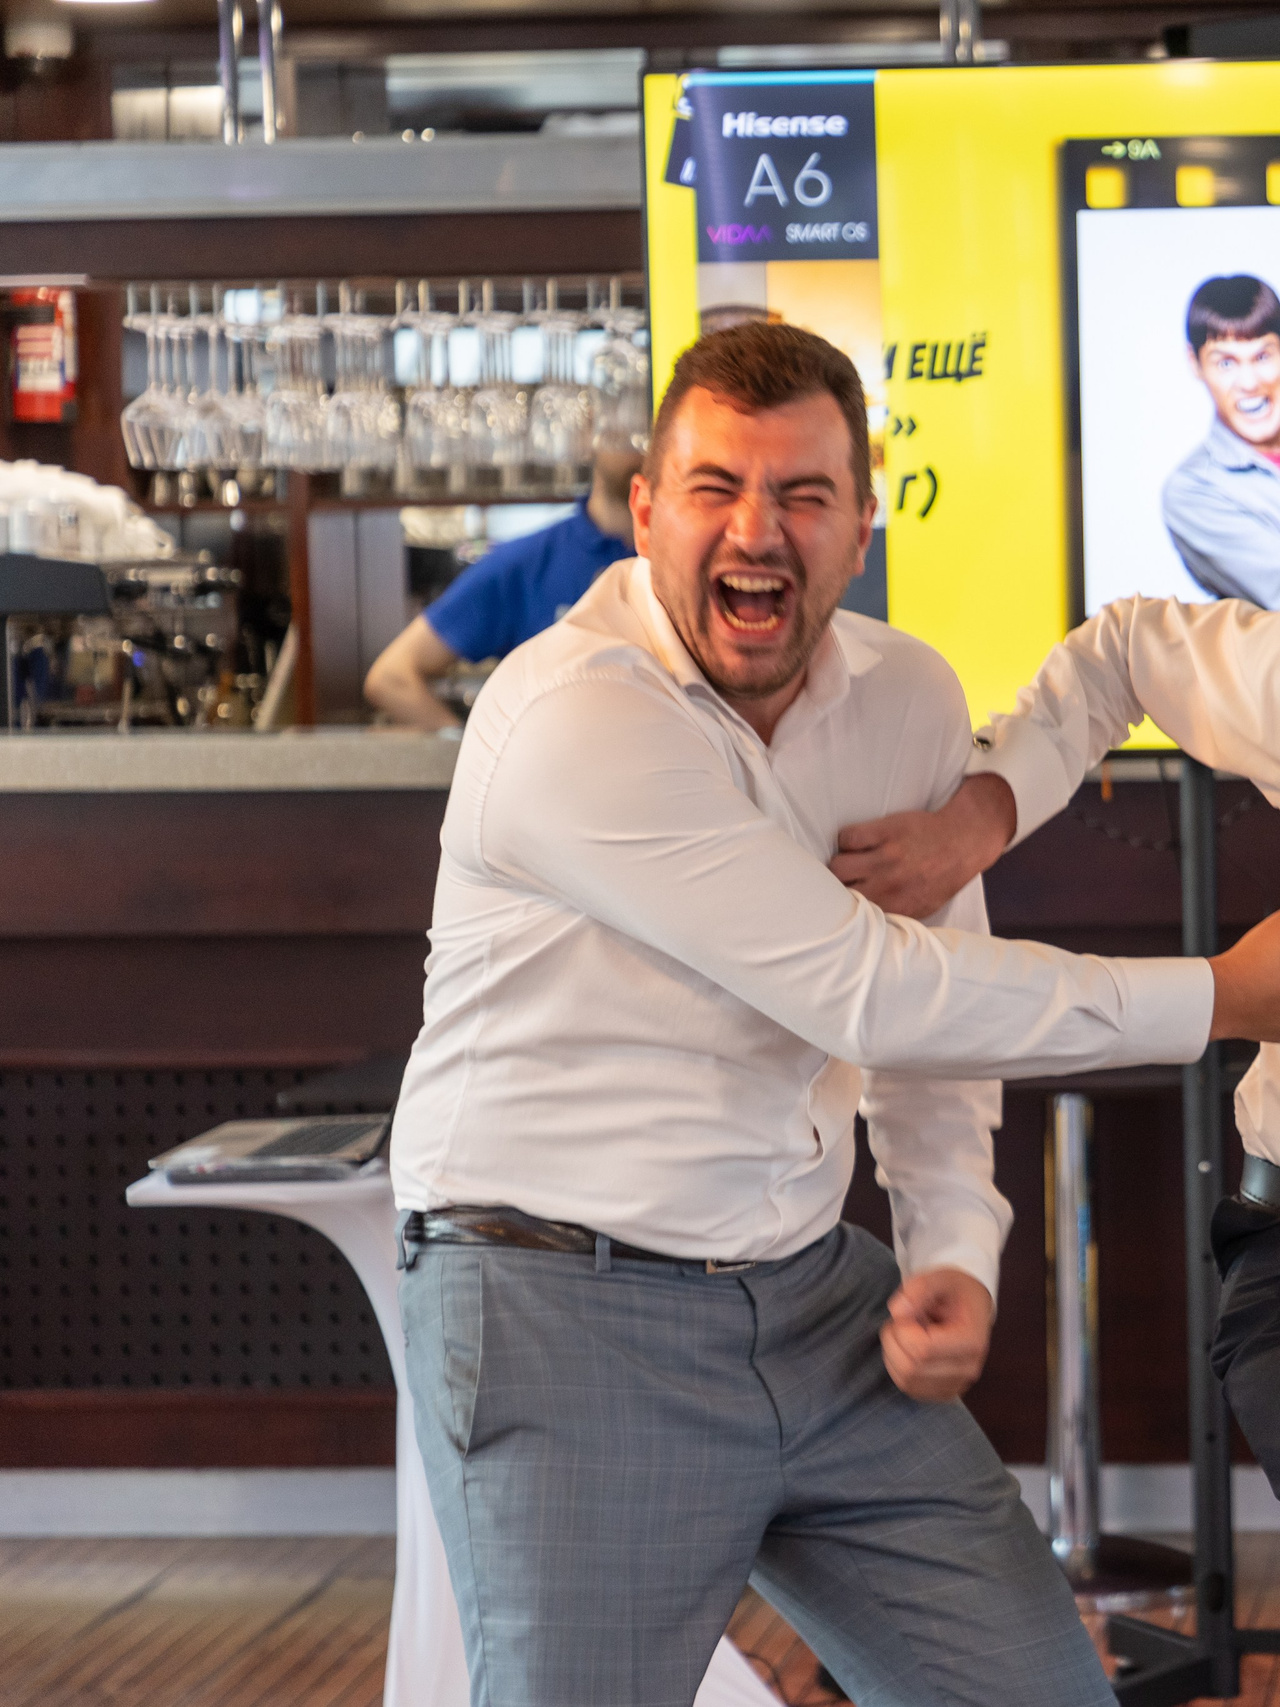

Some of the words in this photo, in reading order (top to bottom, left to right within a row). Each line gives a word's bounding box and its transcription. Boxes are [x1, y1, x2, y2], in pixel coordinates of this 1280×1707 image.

[722, 111, 849, 139] Hisense
[1127, 138, 1162, 160] 9A
[743, 151, 833, 208] A6
[785, 222, 841, 244] SMART
[841, 221, 870, 243] OS
[908, 332, 987, 382] ЕЩЁ
